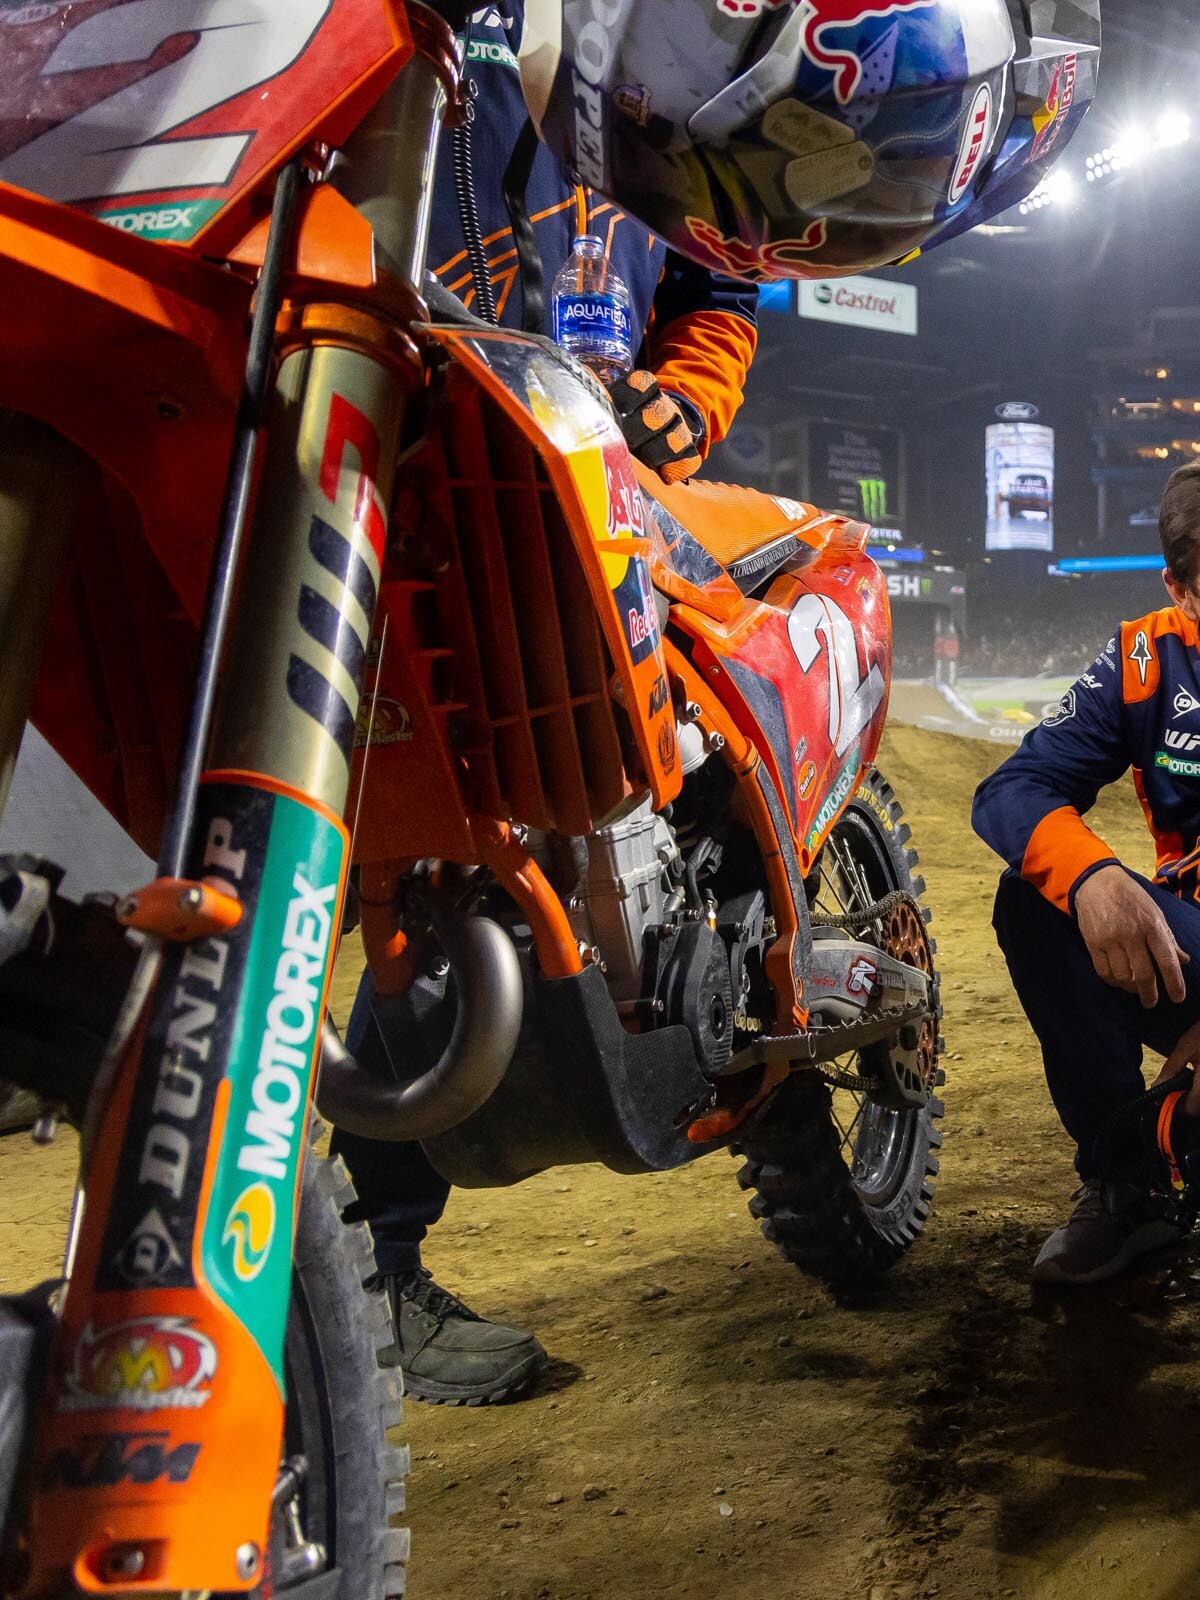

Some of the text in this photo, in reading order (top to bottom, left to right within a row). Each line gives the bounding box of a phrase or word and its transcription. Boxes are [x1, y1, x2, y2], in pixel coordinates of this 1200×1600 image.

[956, 101, 989, 189] BELL
[835, 287, 897, 315] Castrol
[815, 766, 856, 834] MOTOREX
[856, 785, 894, 832] DUNLOP
[139, 816, 248, 1200] DUNLP
[236, 870, 338, 1180] MOTOREX
